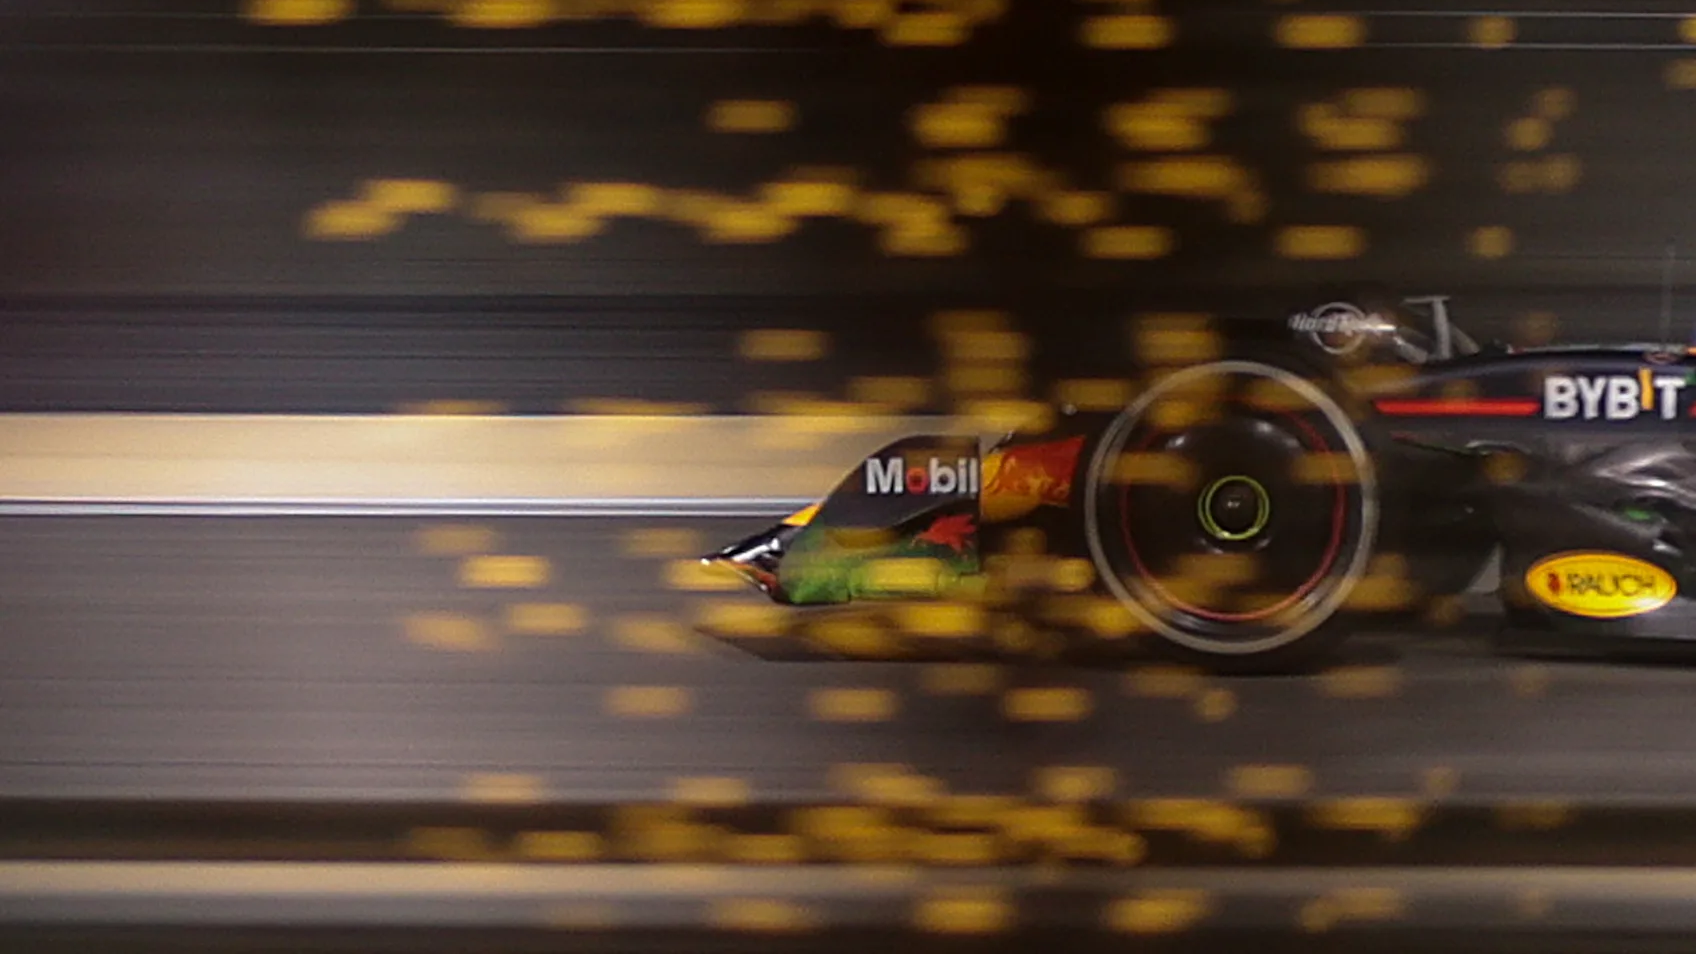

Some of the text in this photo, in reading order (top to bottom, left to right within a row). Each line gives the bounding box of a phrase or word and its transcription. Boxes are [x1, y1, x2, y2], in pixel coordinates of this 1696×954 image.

[1544, 367, 1686, 420] BYBIT
[866, 457, 977, 494] Mobil
[1566, 573, 1656, 597] RAUCH
